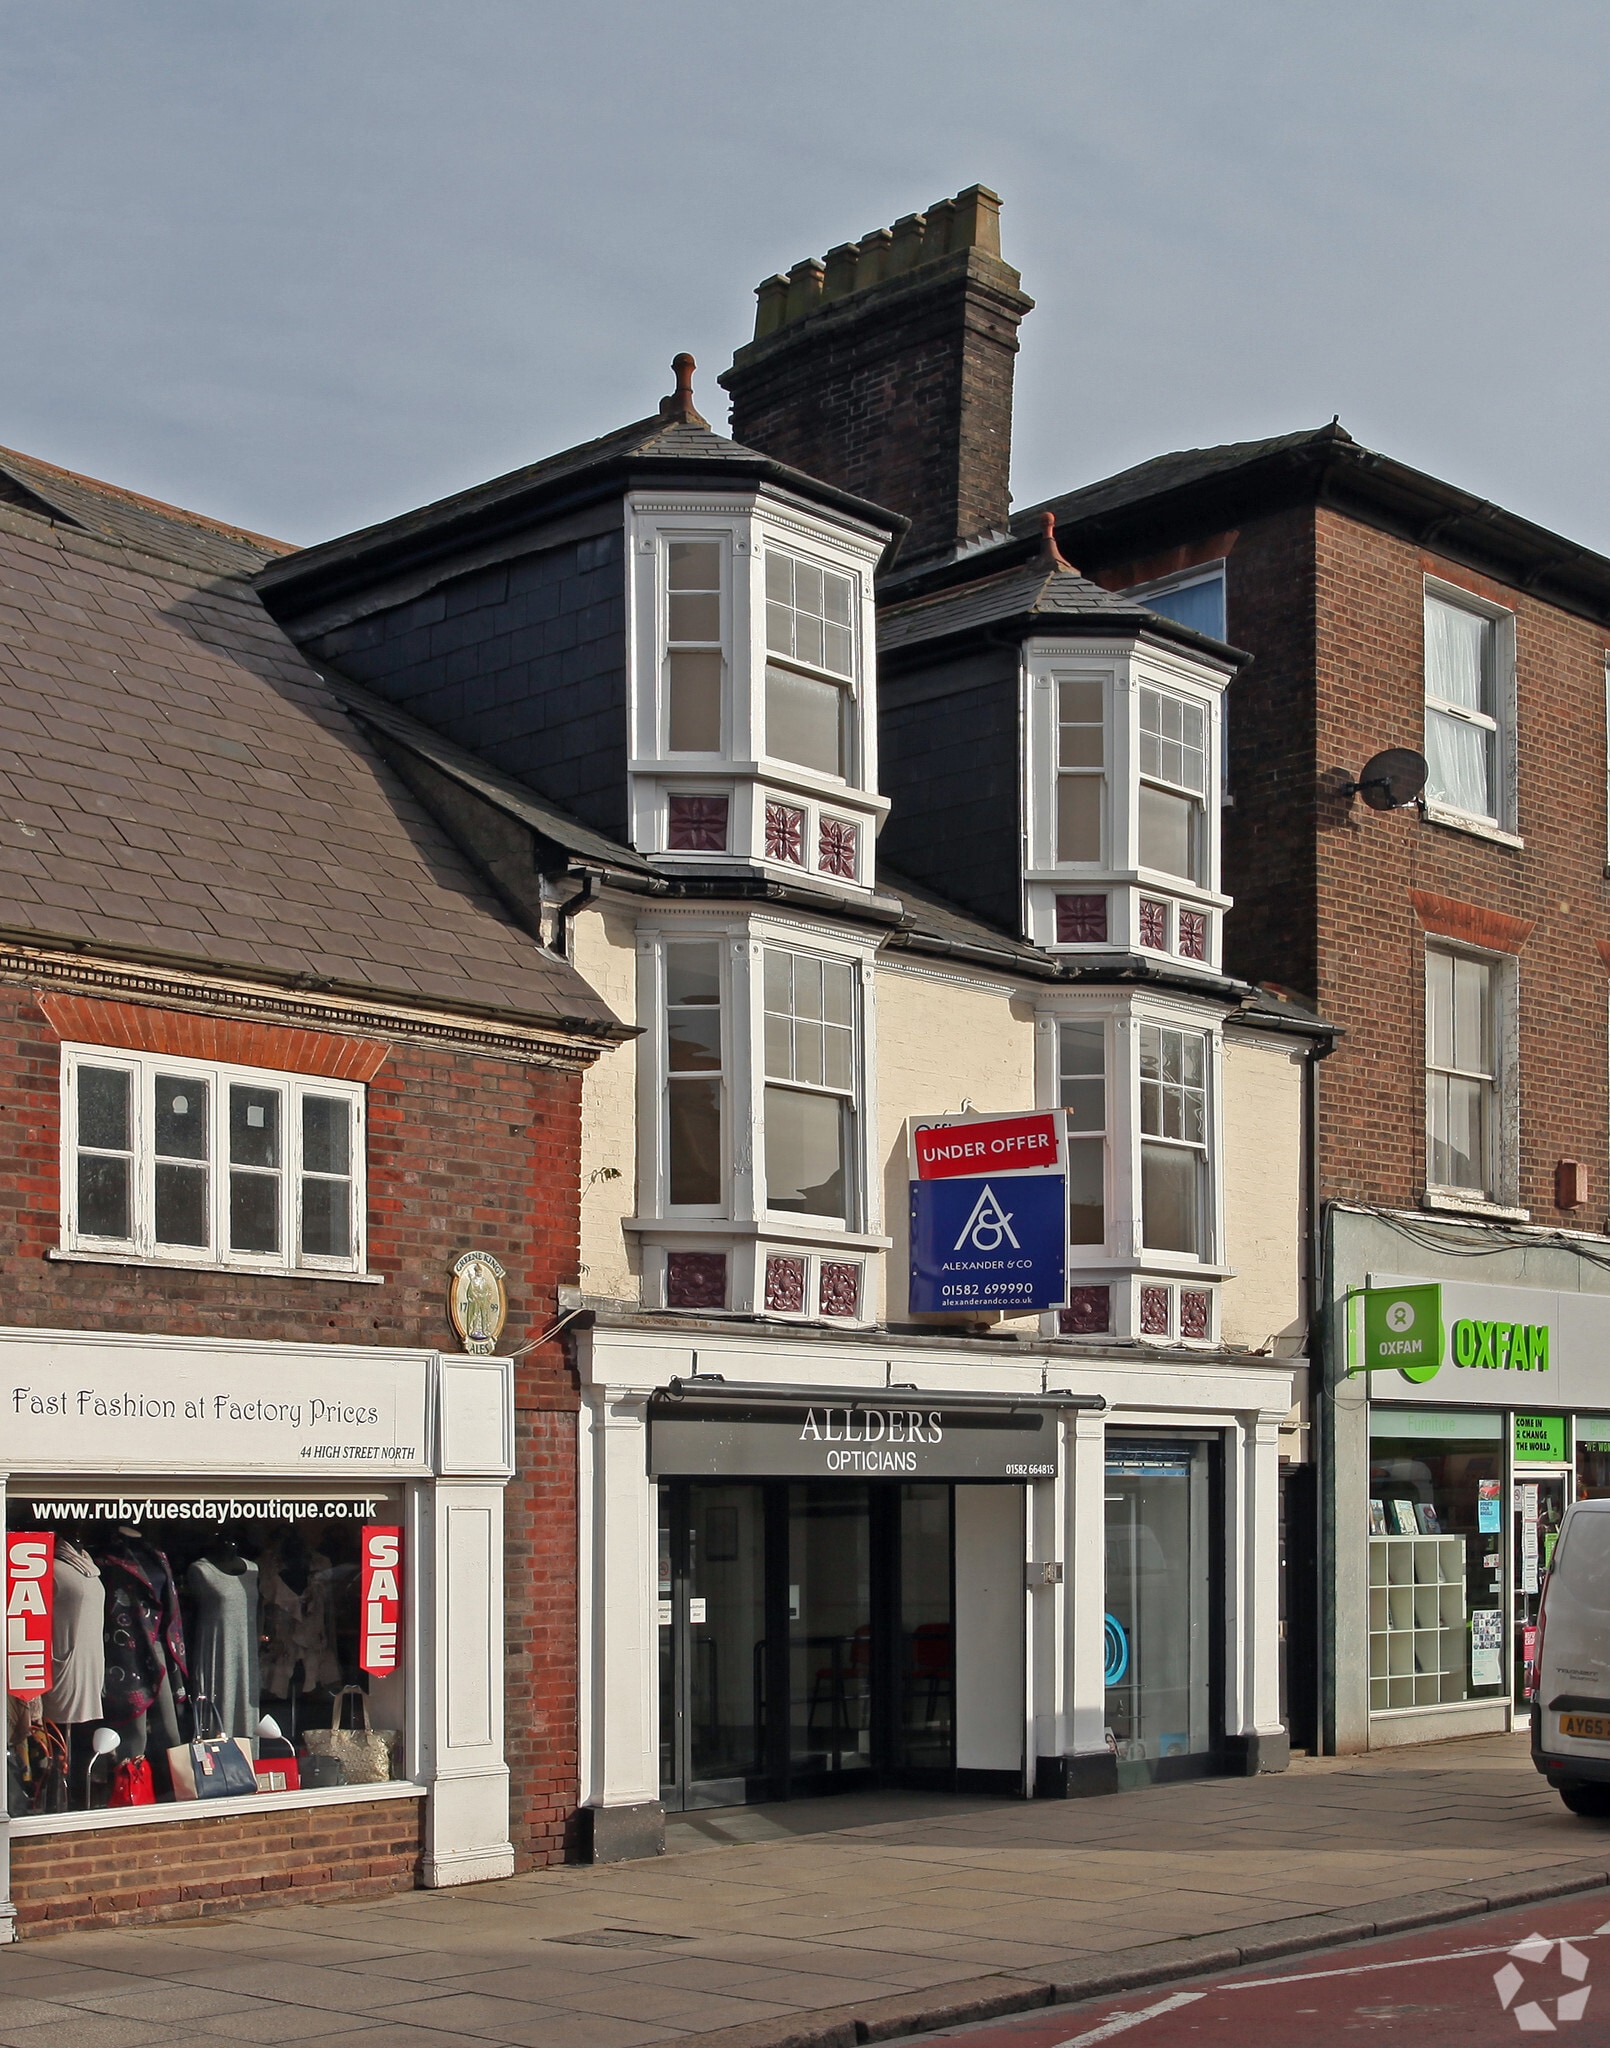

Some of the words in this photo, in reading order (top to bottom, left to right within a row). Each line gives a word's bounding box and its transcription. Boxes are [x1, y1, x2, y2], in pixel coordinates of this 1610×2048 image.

[923, 1142, 986, 1162] UNDER
[990, 1133, 1049, 1153] OFFER
[456, 1252, 482, 1272] GREENE
[483, 1255, 501, 1274] KING
[942, 1261, 1004, 1271] ALEXANDER
[1007, 1261, 1015, 1269] &
[1016, 1260, 1032, 1269] CO
[942, 1285, 979, 1295] 01582
[984, 1283, 1033, 1294] 699990
[942, 1297, 1032, 1306] alexanderandco.co.uk
[470, 1343, 489, 1354] ALES
[1379, 1339, 1422, 1355] OXFAM
[1456, 1318, 1549, 1371] OXFAM
[13, 1387, 67, 1415] Fast
[77, 1389, 175, 1417] Fashion
[185, 1397, 205, 1418] at
[214, 1394, 301, 1428] Factory
[309, 1399, 378, 1426] Prices
[799, 1408, 943, 1444] ALLDERS
[1516, 1419, 1534, 1427] COME
[1522, 1431, 1547, 1439] CHANGE
[300, 1446, 312, 1458] 44
[314, 1446, 340, 1458] HIGH
[343, 1447, 380, 1459] STREET
[382, 1447, 415, 1459] NORTH
[1516, 1442, 1528, 1450] THE
[1529, 1443, 1550, 1451] WORLD
[826, 1450, 917, 1471] OPTICIANS
[1006, 1464, 1027, 1474] 01582
[1029, 1465, 1054, 1475] 664815
[32, 1499, 376, 1524] www.rubytuesdayboutique.co.uk
[366, 1535, 399, 1667] SALE
[7, 1542, 48, 1690] SALE
